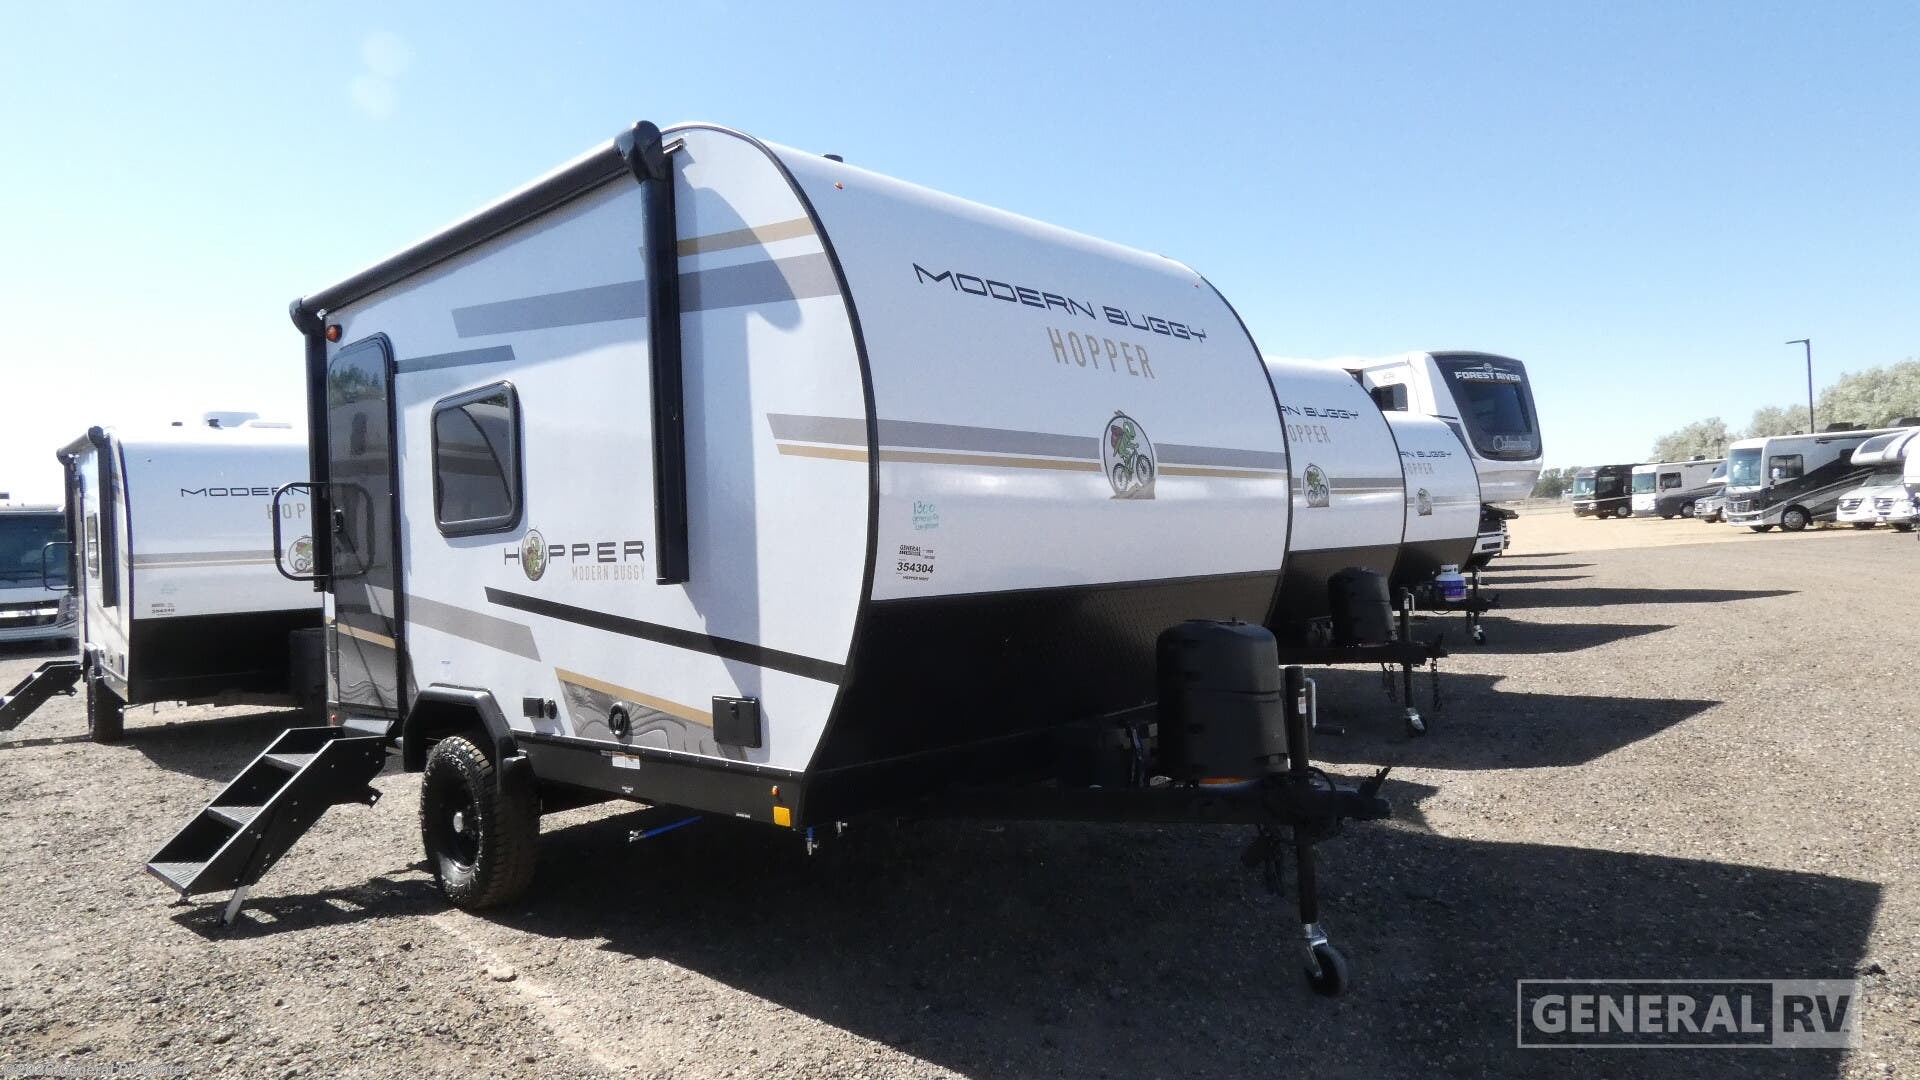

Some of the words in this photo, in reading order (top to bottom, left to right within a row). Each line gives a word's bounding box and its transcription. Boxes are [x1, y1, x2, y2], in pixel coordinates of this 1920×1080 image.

[912, 262, 1096, 320] MODERN
[1102, 305, 1207, 343] BUGGY
[1047, 326, 1155, 379] HOPPER
[1454, 371, 1495, 380] FOREST
[1496, 372, 1521, 382] RIVER
[1280, 405, 1301, 416] RN
[1303, 407, 1359, 420] BUGGY
[1288, 423, 1331, 444] OPPER
[1405, 462, 1433, 475] OPPER
[266, 503, 306, 520] HOP
[571, 566, 609, 582] MODERN
[614, 564, 645, 581] BUGGY
[896, 562, 934, 574] 354304
